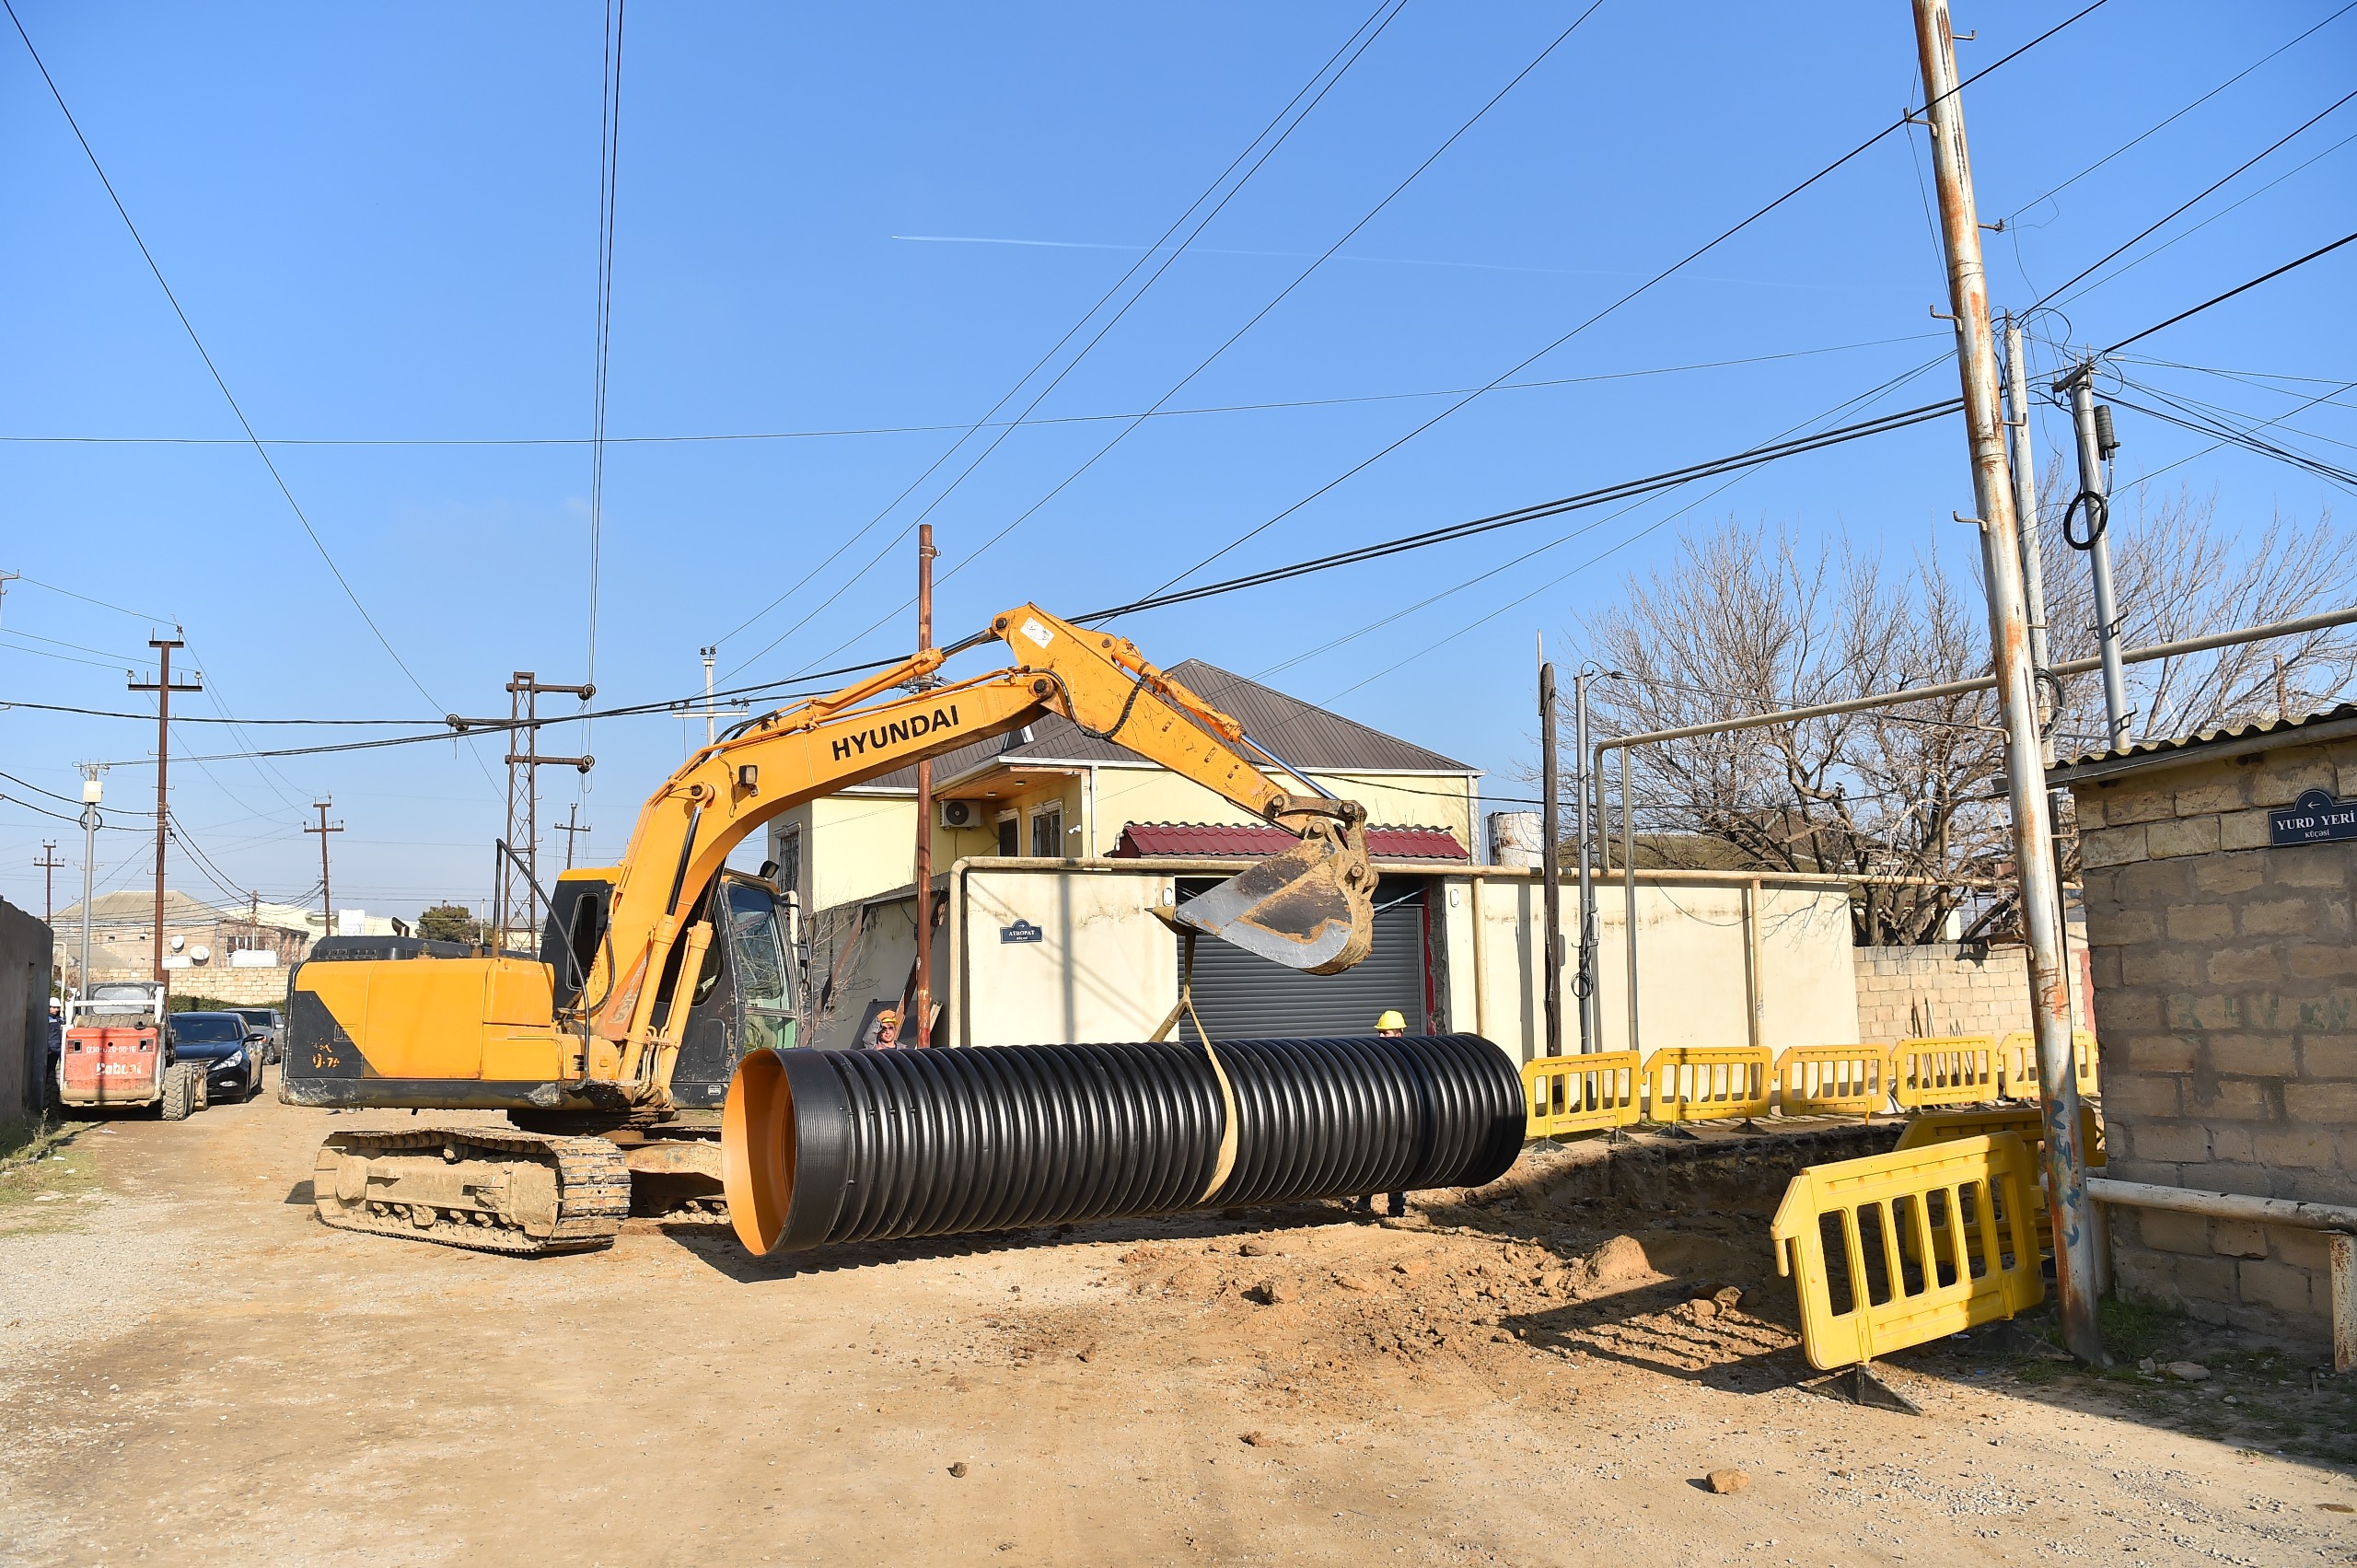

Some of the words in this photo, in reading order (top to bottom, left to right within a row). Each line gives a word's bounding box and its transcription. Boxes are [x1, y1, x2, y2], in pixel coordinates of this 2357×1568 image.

[831, 704, 958, 761] HYUNDAI
[2277, 817, 2315, 830] YURD
[2320, 809, 2356, 826] YERİ
